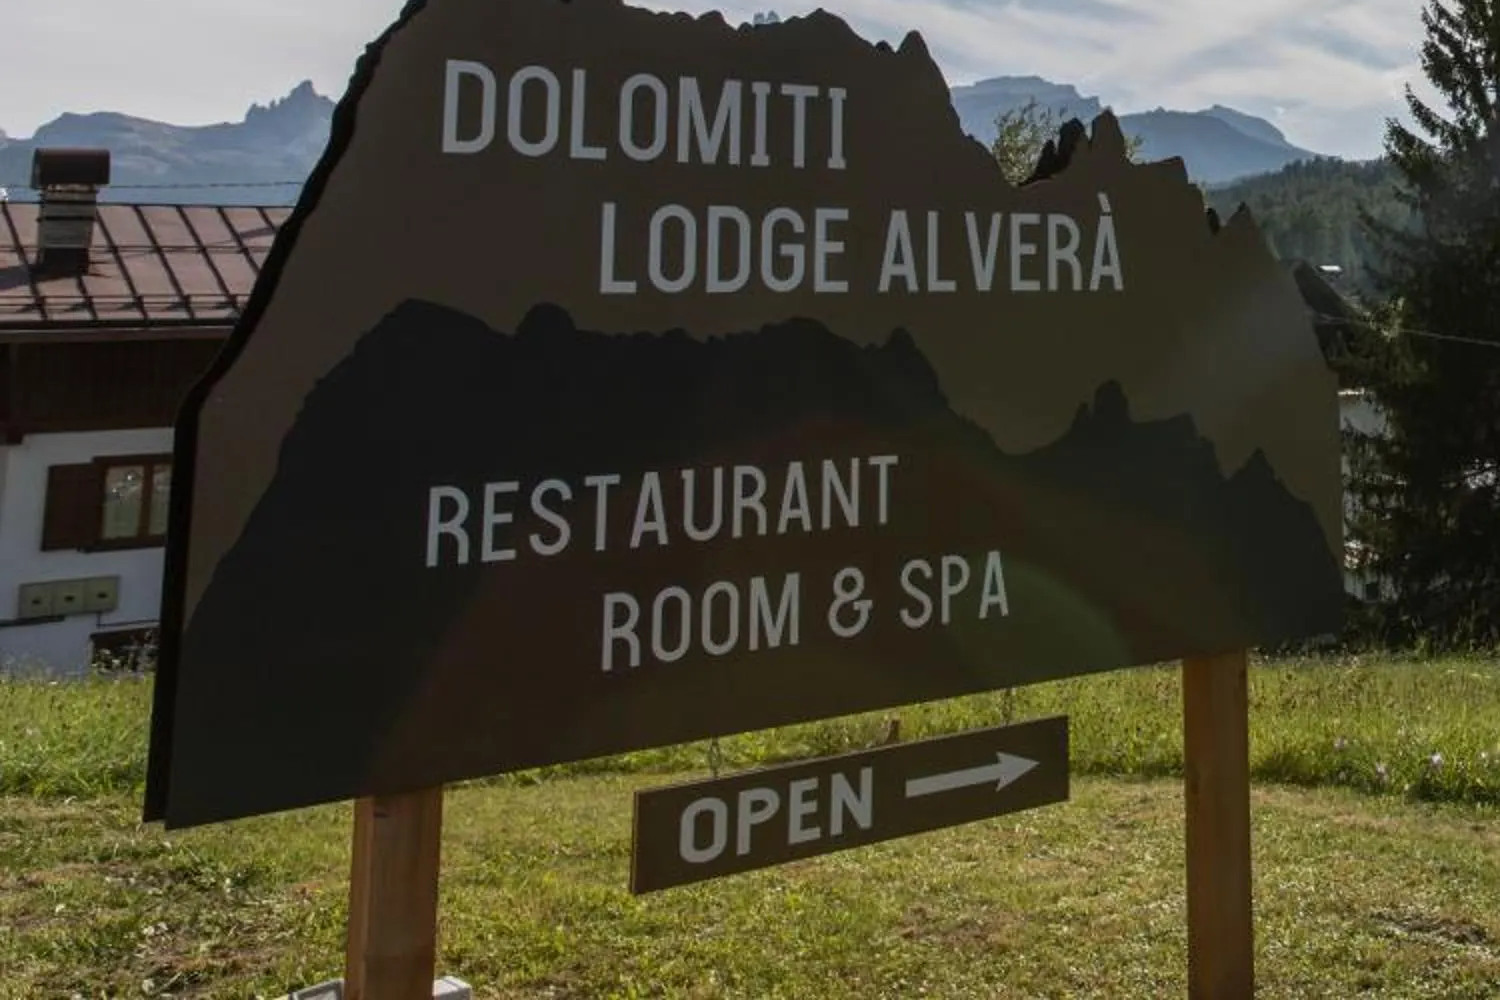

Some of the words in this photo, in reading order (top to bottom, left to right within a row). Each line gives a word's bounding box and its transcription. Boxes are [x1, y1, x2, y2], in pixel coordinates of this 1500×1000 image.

[442, 59, 848, 169] DOLOMITI
[600, 202, 849, 293] LODGE
[878, 192, 1125, 293] ALVERÀ
[425, 454, 899, 568] RESTAURANT
[601, 572, 800, 671] ROOM
[828, 567, 873, 637] &
[900, 550, 1010, 628] SPA
[678, 766, 874, 864] OPEN
